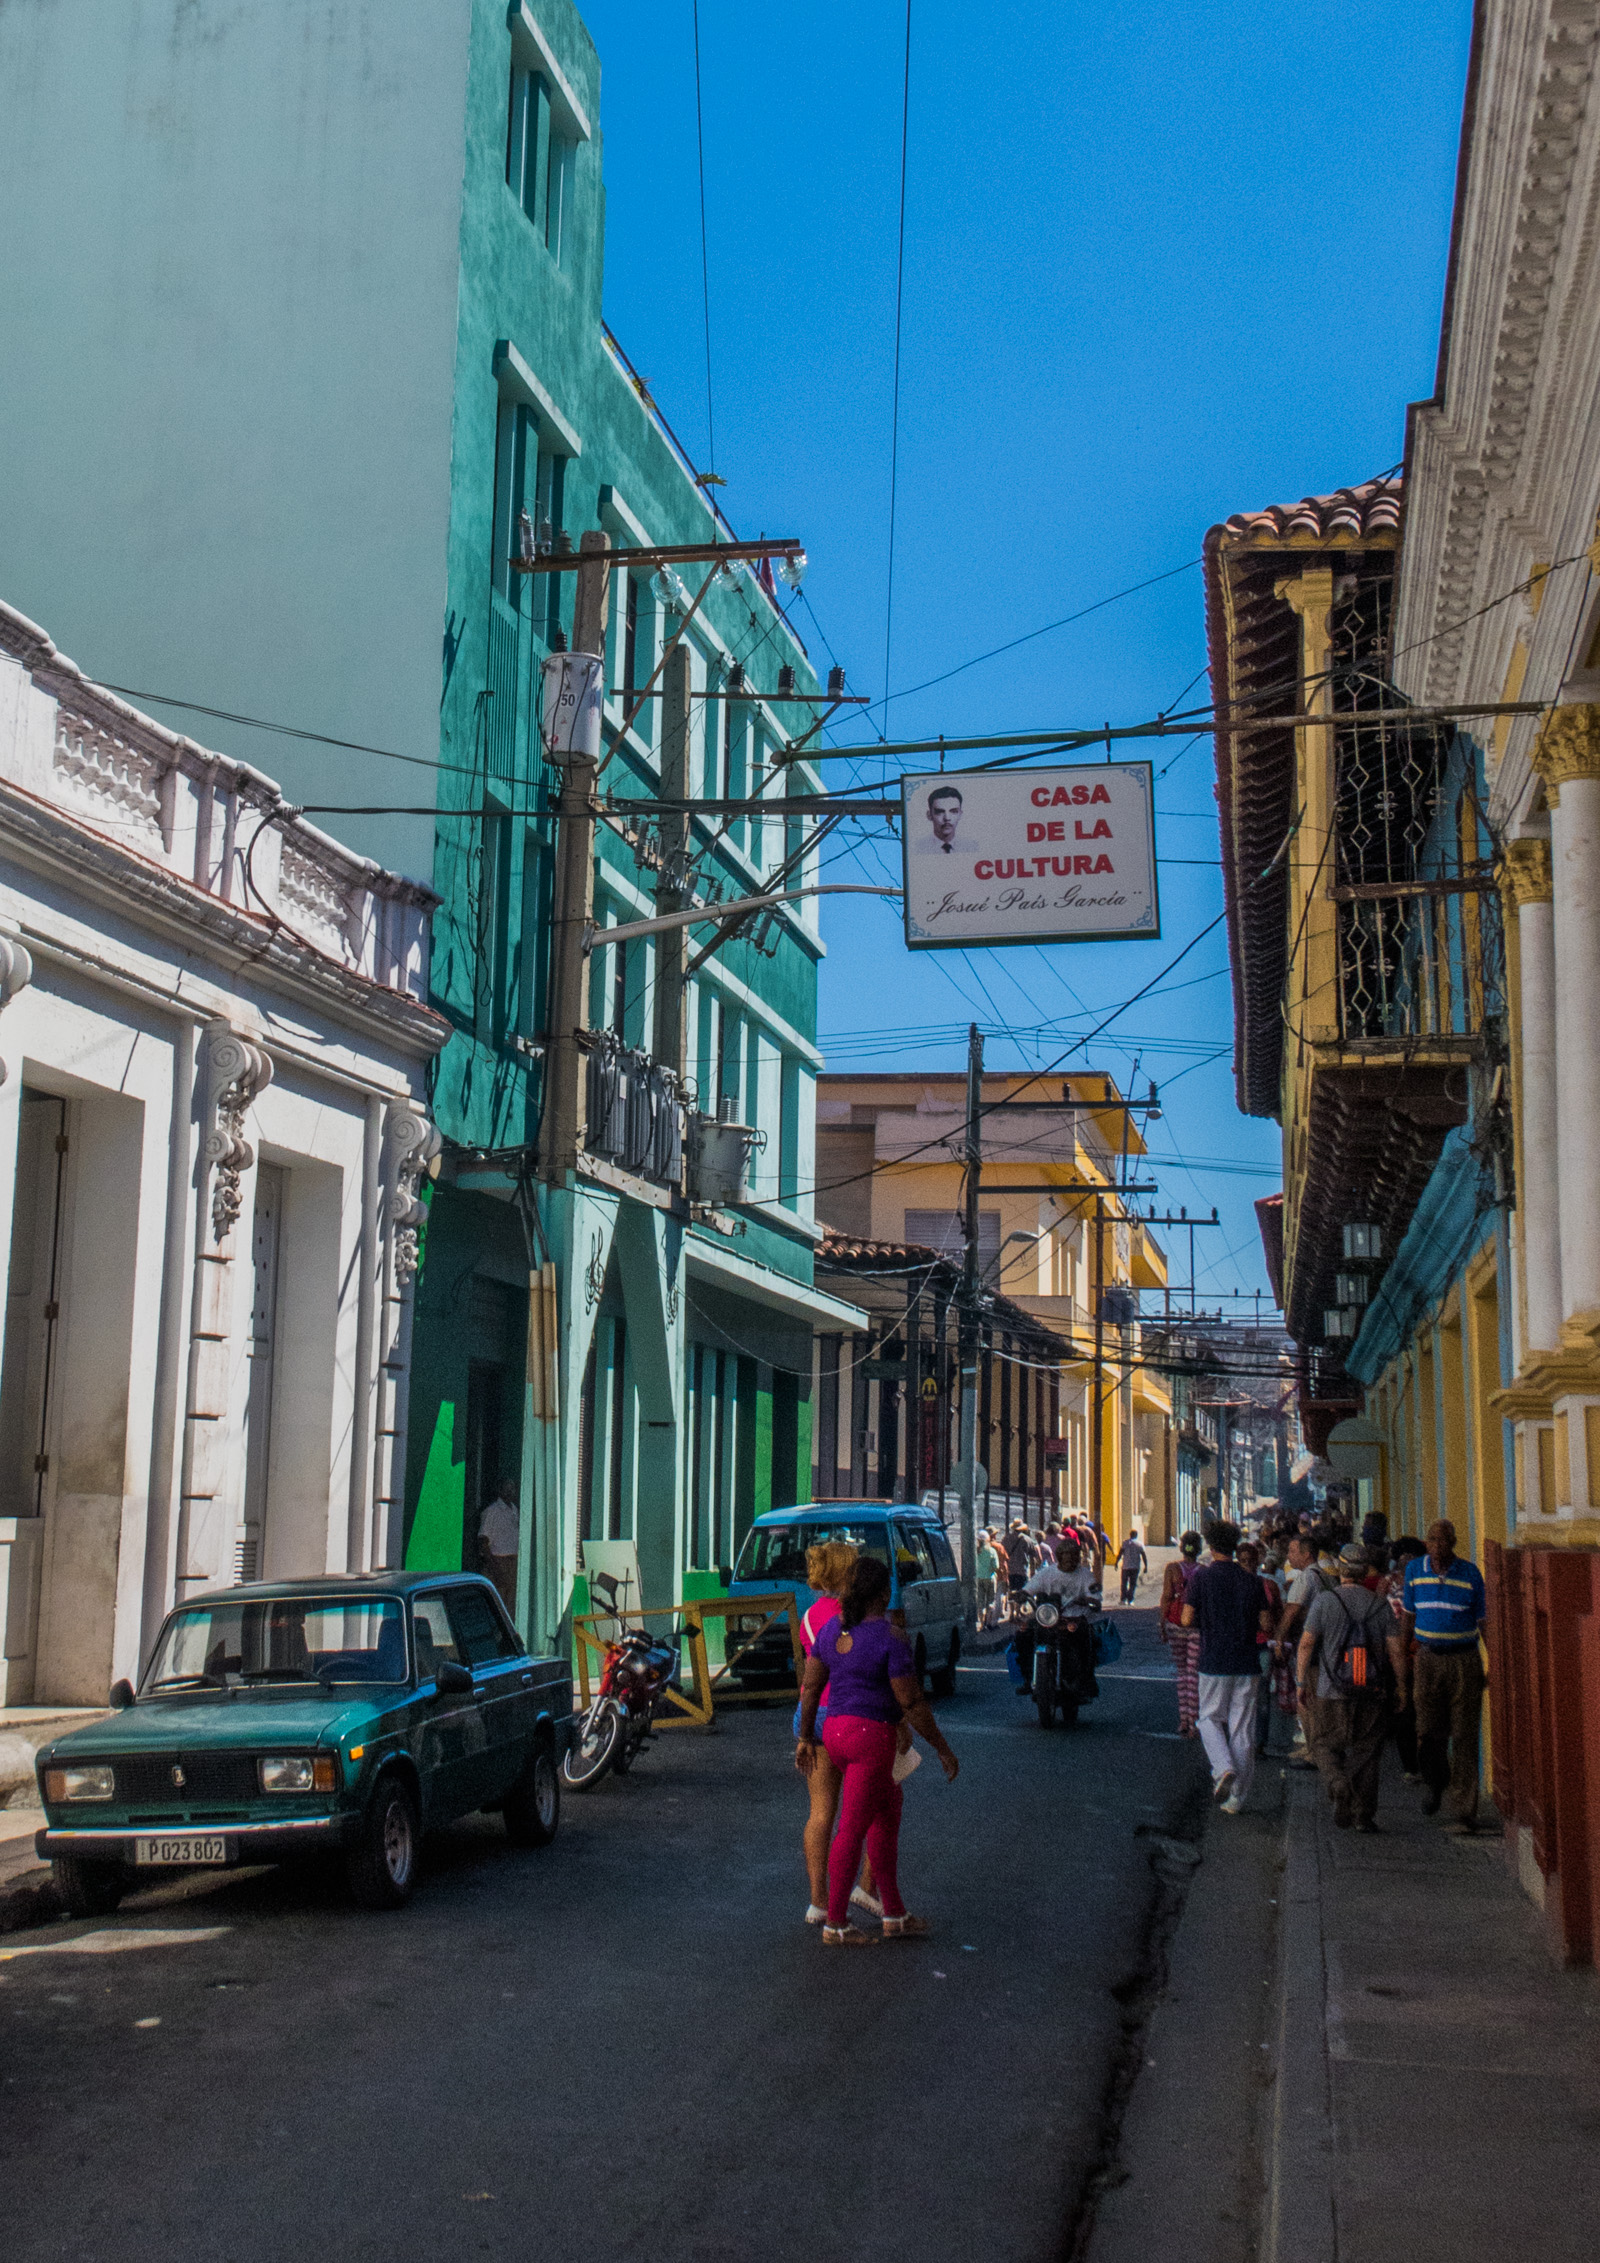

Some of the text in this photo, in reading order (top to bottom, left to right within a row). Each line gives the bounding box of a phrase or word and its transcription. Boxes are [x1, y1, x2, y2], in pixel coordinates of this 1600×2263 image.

[561, 694, 576, 707] 50
[1031, 784, 1112, 807] CASA
[1026, 819, 1114, 843] DE LA
[974, 854, 1115, 880] CULTURA
[995, 887, 1049, 911] País
